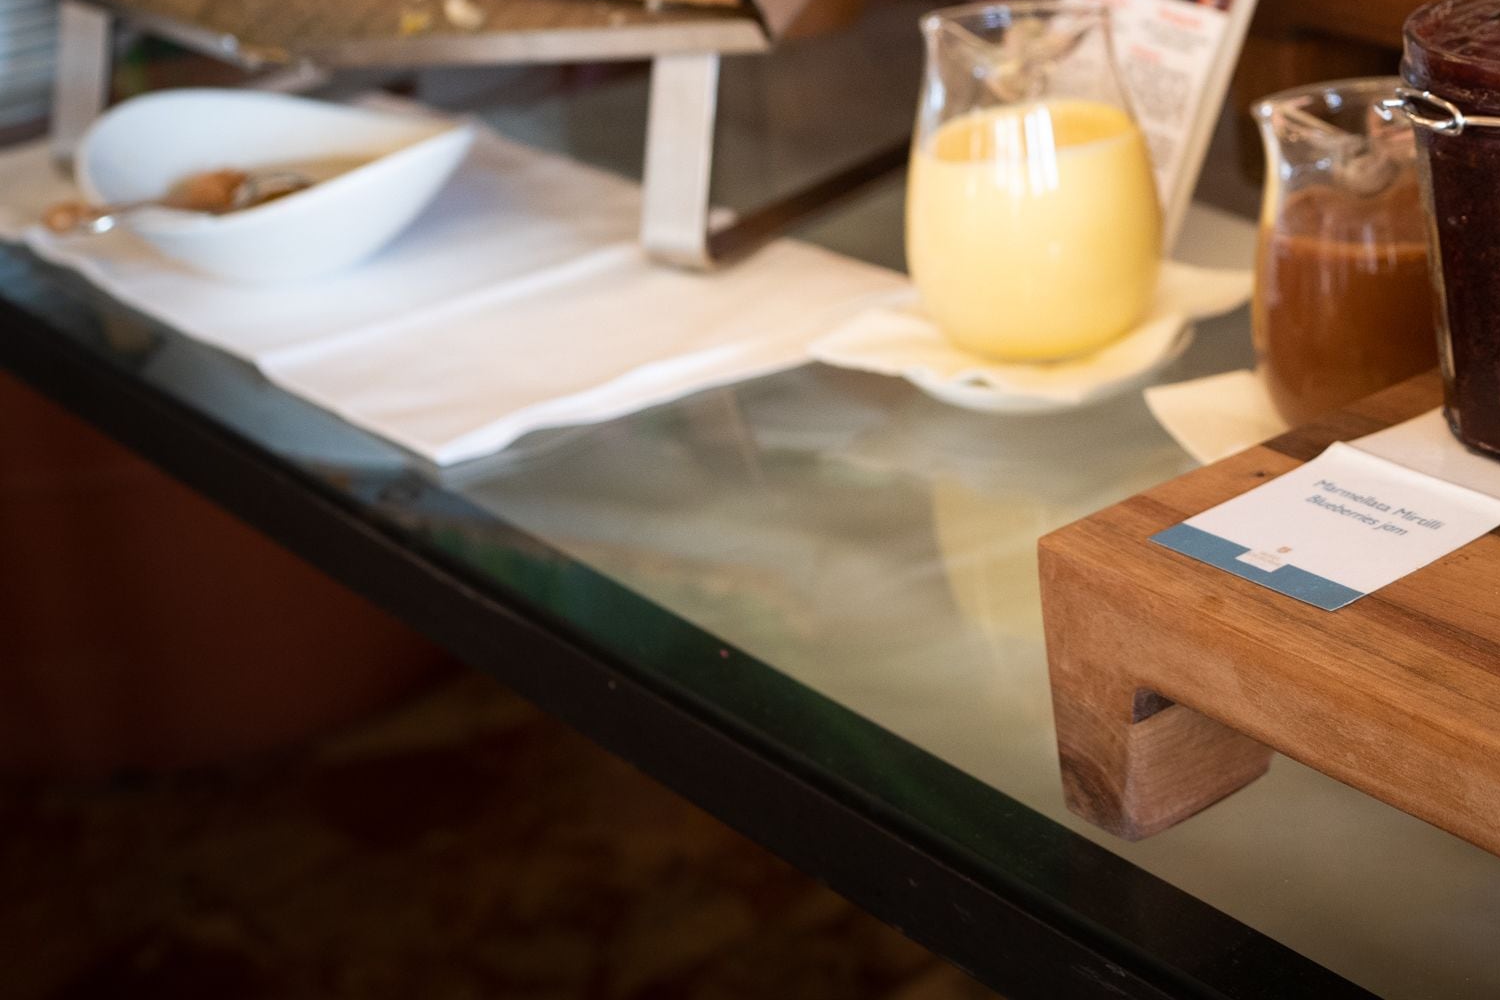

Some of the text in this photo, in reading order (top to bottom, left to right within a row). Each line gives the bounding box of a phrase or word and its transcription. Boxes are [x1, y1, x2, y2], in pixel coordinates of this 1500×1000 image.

[1305, 494, 1408, 537] Blueberries jam
[1313, 479, 1444, 531] Marmellata Mirtilli
